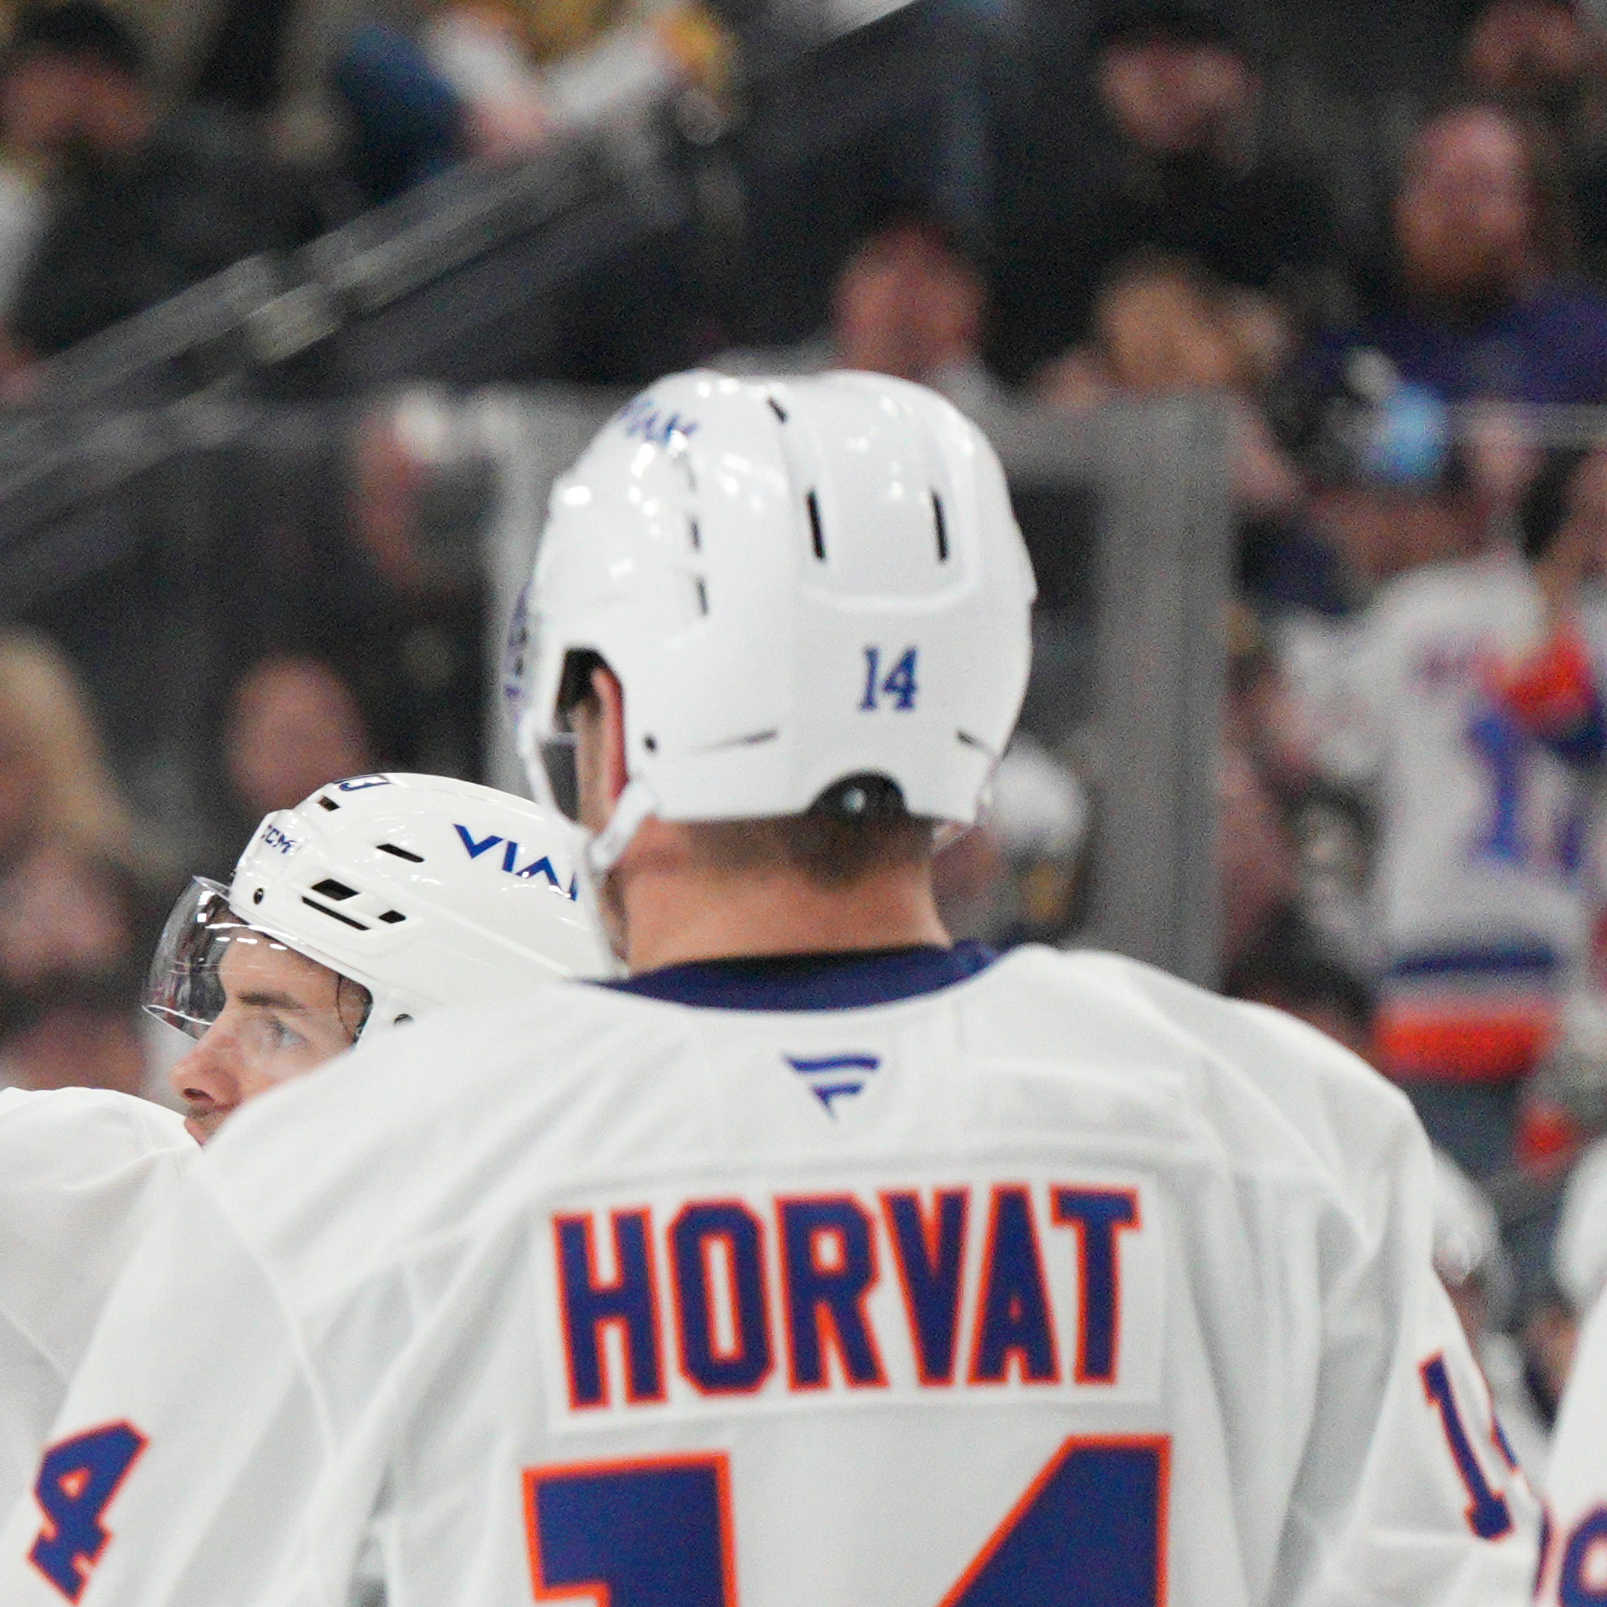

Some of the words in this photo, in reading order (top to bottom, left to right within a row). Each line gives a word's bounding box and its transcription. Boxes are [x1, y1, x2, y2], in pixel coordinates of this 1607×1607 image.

[859, 646, 920, 712] 14
[453, 824, 578, 901] VIA
[551, 1182, 1141, 1412] HORVAT
